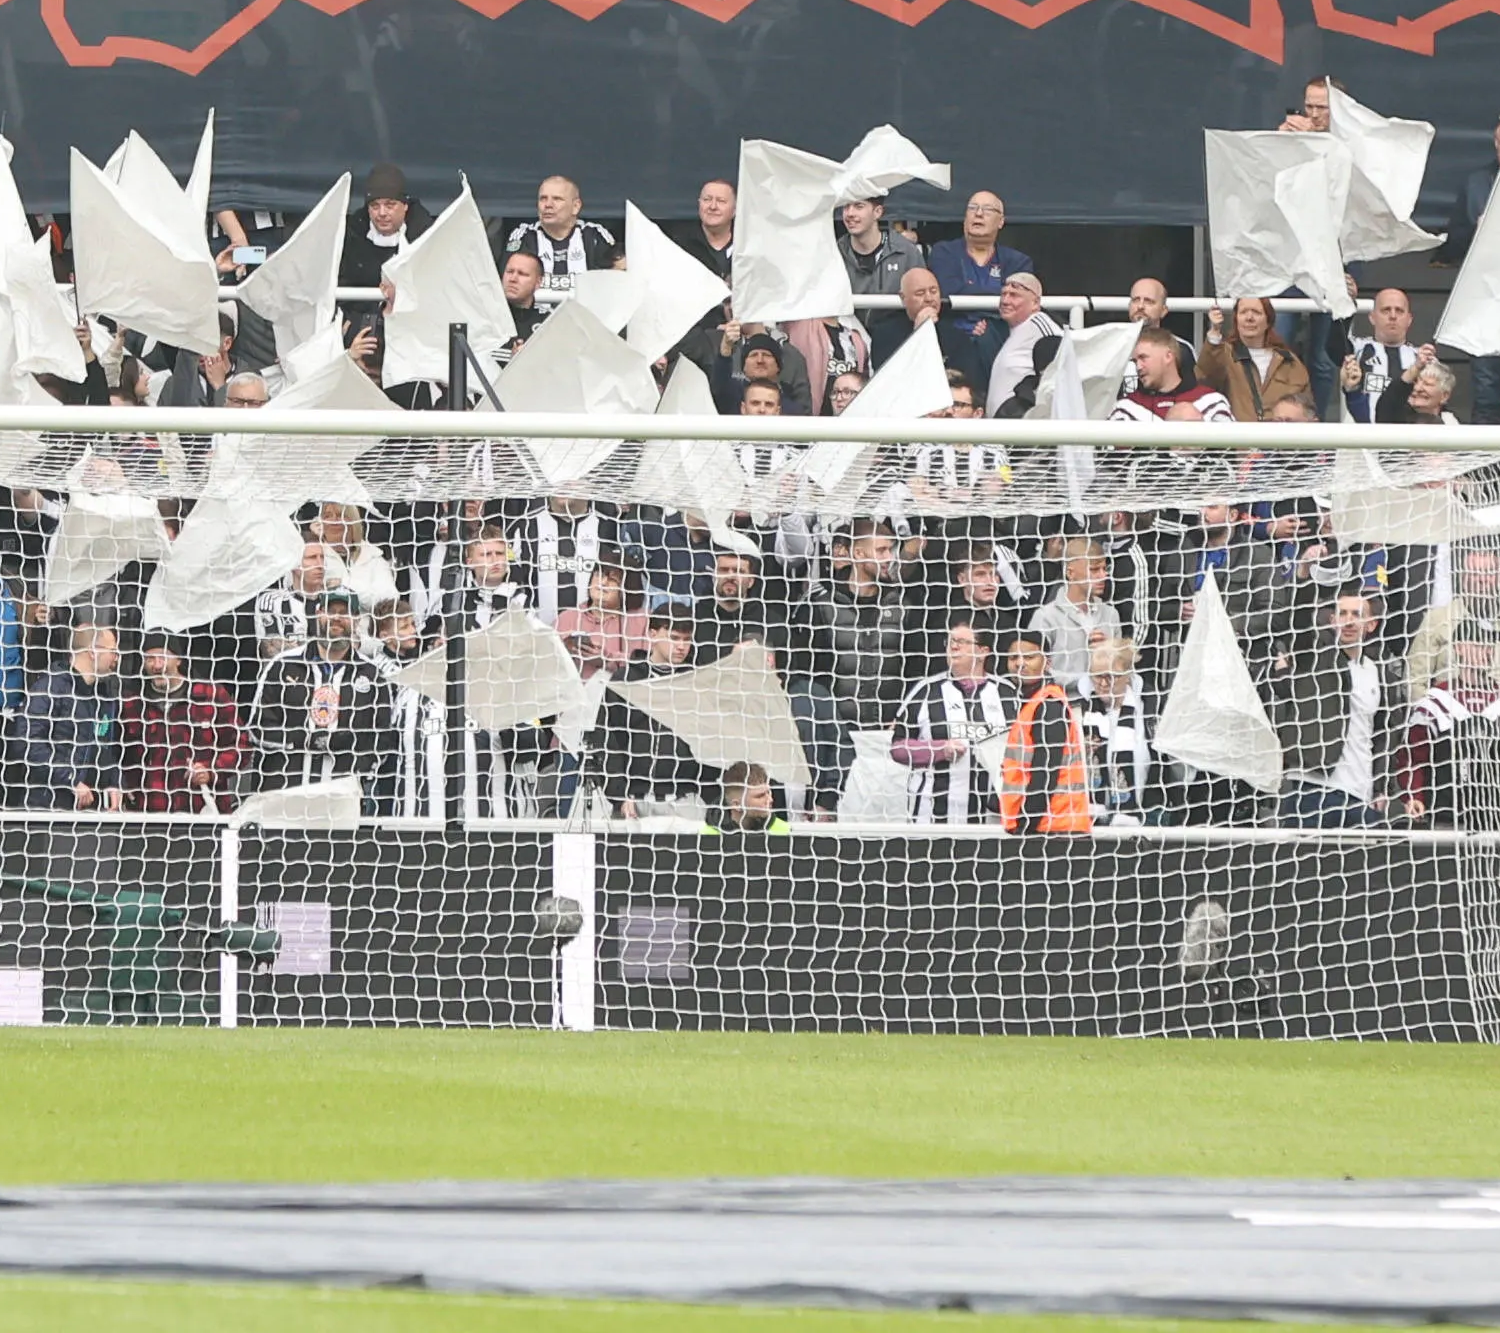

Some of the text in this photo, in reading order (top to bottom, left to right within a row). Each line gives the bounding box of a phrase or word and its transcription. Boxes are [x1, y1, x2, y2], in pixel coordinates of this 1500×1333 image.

[550, 272, 576, 290] sel
[827, 358, 856, 376] sel
[556, 555, 596, 573] sela
